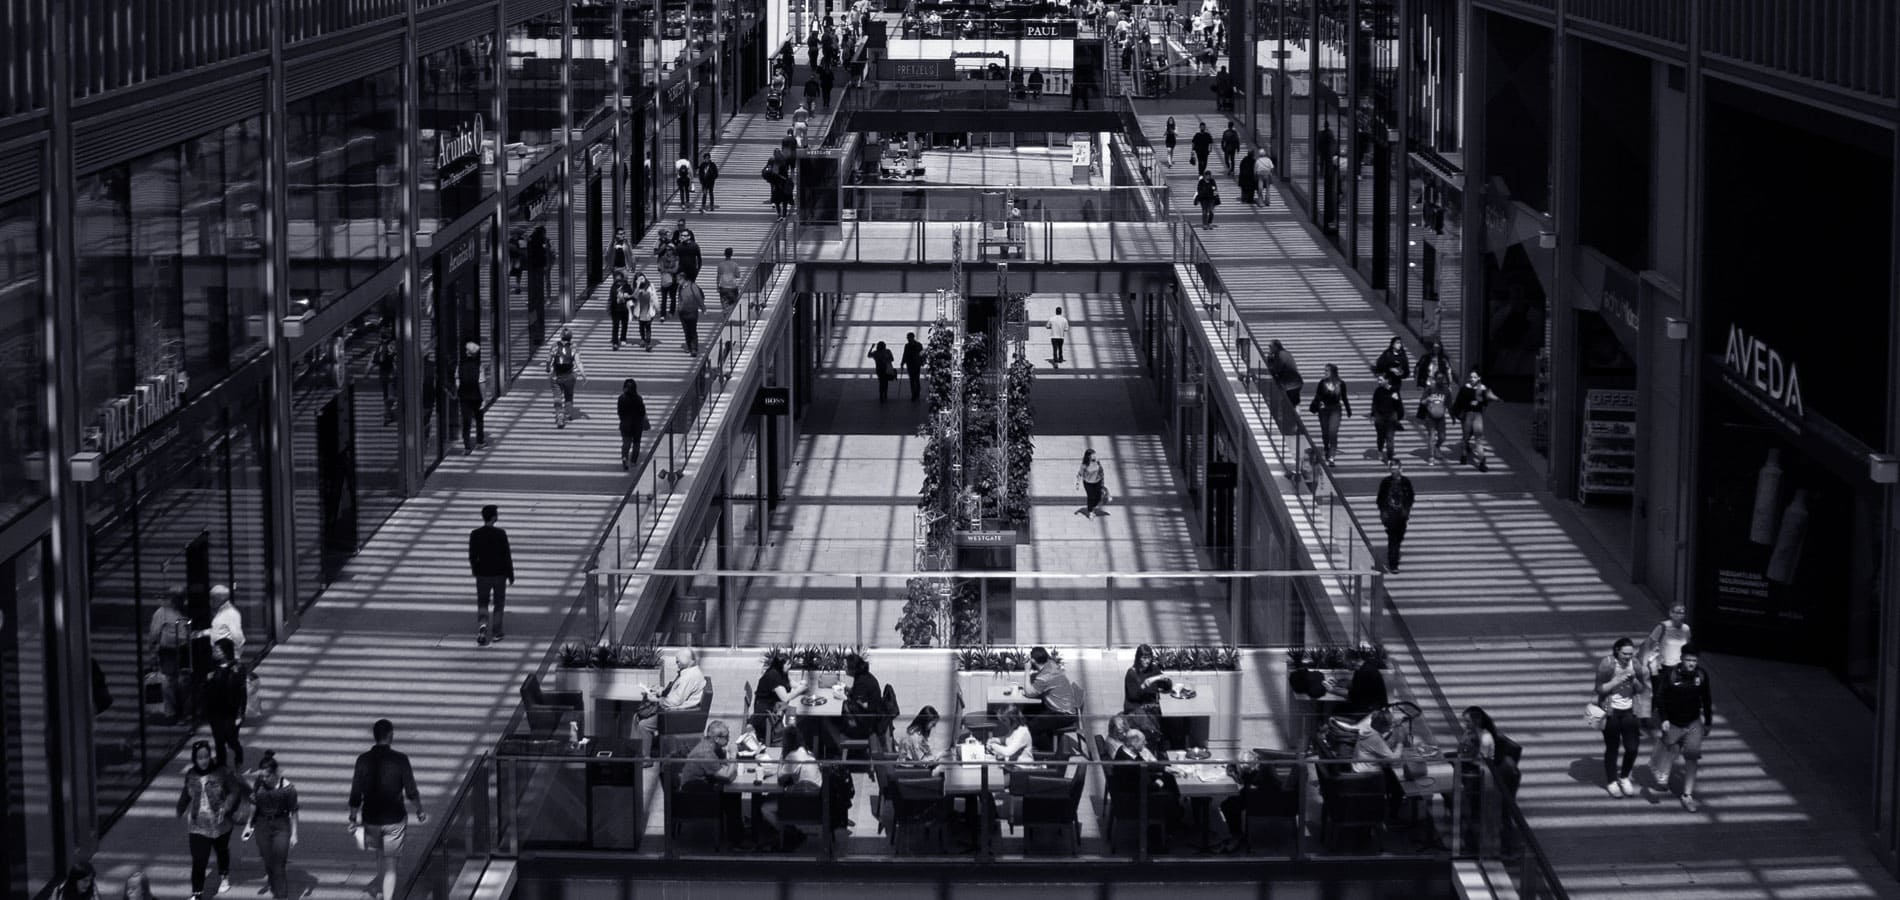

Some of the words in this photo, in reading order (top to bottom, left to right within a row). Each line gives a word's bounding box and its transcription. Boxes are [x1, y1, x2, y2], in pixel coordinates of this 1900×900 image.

[1027, 26, 1059, 36] PAUL
[897, 65, 935, 75] PRETZELS
[437, 121, 473, 169] Acuitis
[1725, 320, 1804, 417] AVEDA
